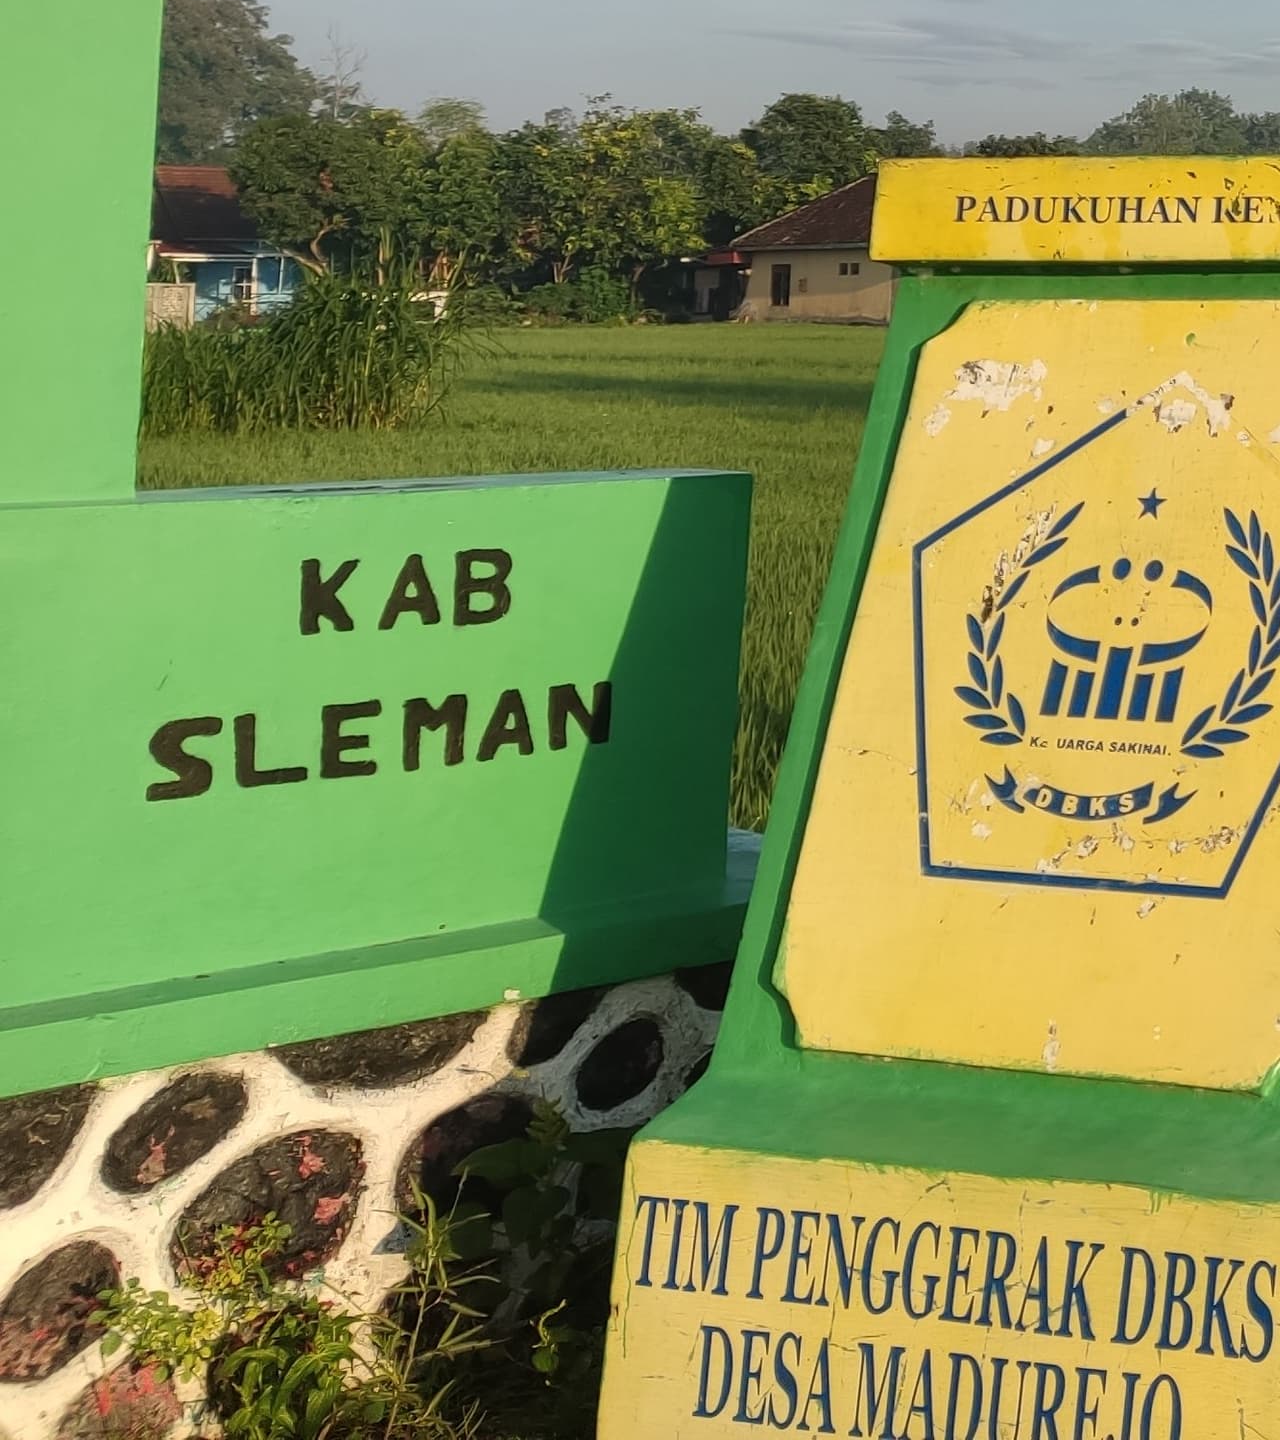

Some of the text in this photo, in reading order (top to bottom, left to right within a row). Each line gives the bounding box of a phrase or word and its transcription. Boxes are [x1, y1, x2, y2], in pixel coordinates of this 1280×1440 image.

[953, 194, 1199, 225] PADUKUHAN
[300, 547, 513, 636] KAB
[145, 680, 613, 802] SLEMAN
[1029, 735, 1105, 753] KUARGA
[1034, 786, 1136, 818] DBKS
[633, 1194, 1278, 1364] TIM PENGGERAK DBKS
[691, 1324, 1184, 1440] DESA MADUREJO
